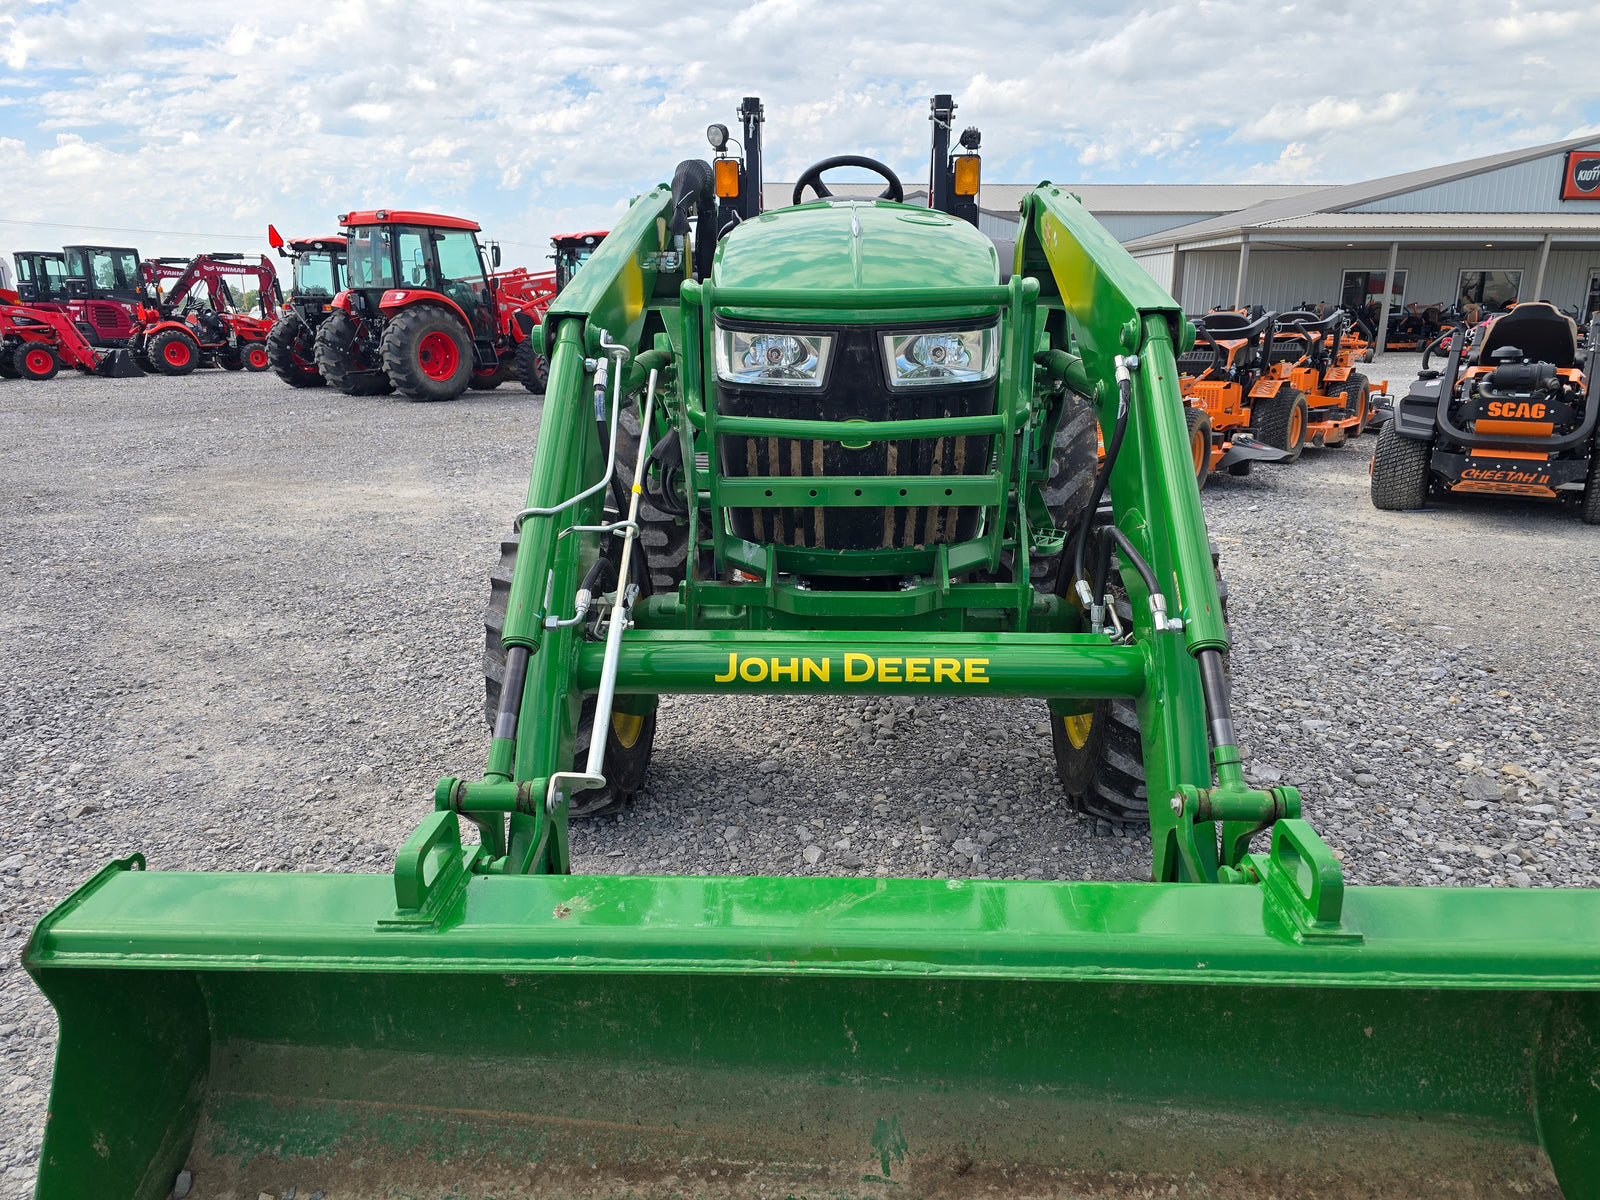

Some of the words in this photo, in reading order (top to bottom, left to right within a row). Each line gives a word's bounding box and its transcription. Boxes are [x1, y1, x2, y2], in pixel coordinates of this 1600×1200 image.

[215, 266, 247, 274] YANMAR
[1487, 401, 1546, 419] SCAG
[1460, 469, 1537, 484] CHEETAH
[1538, 475, 1550, 484] II
[714, 652, 830, 682] JOHN
[844, 652, 990, 683] DEERE
